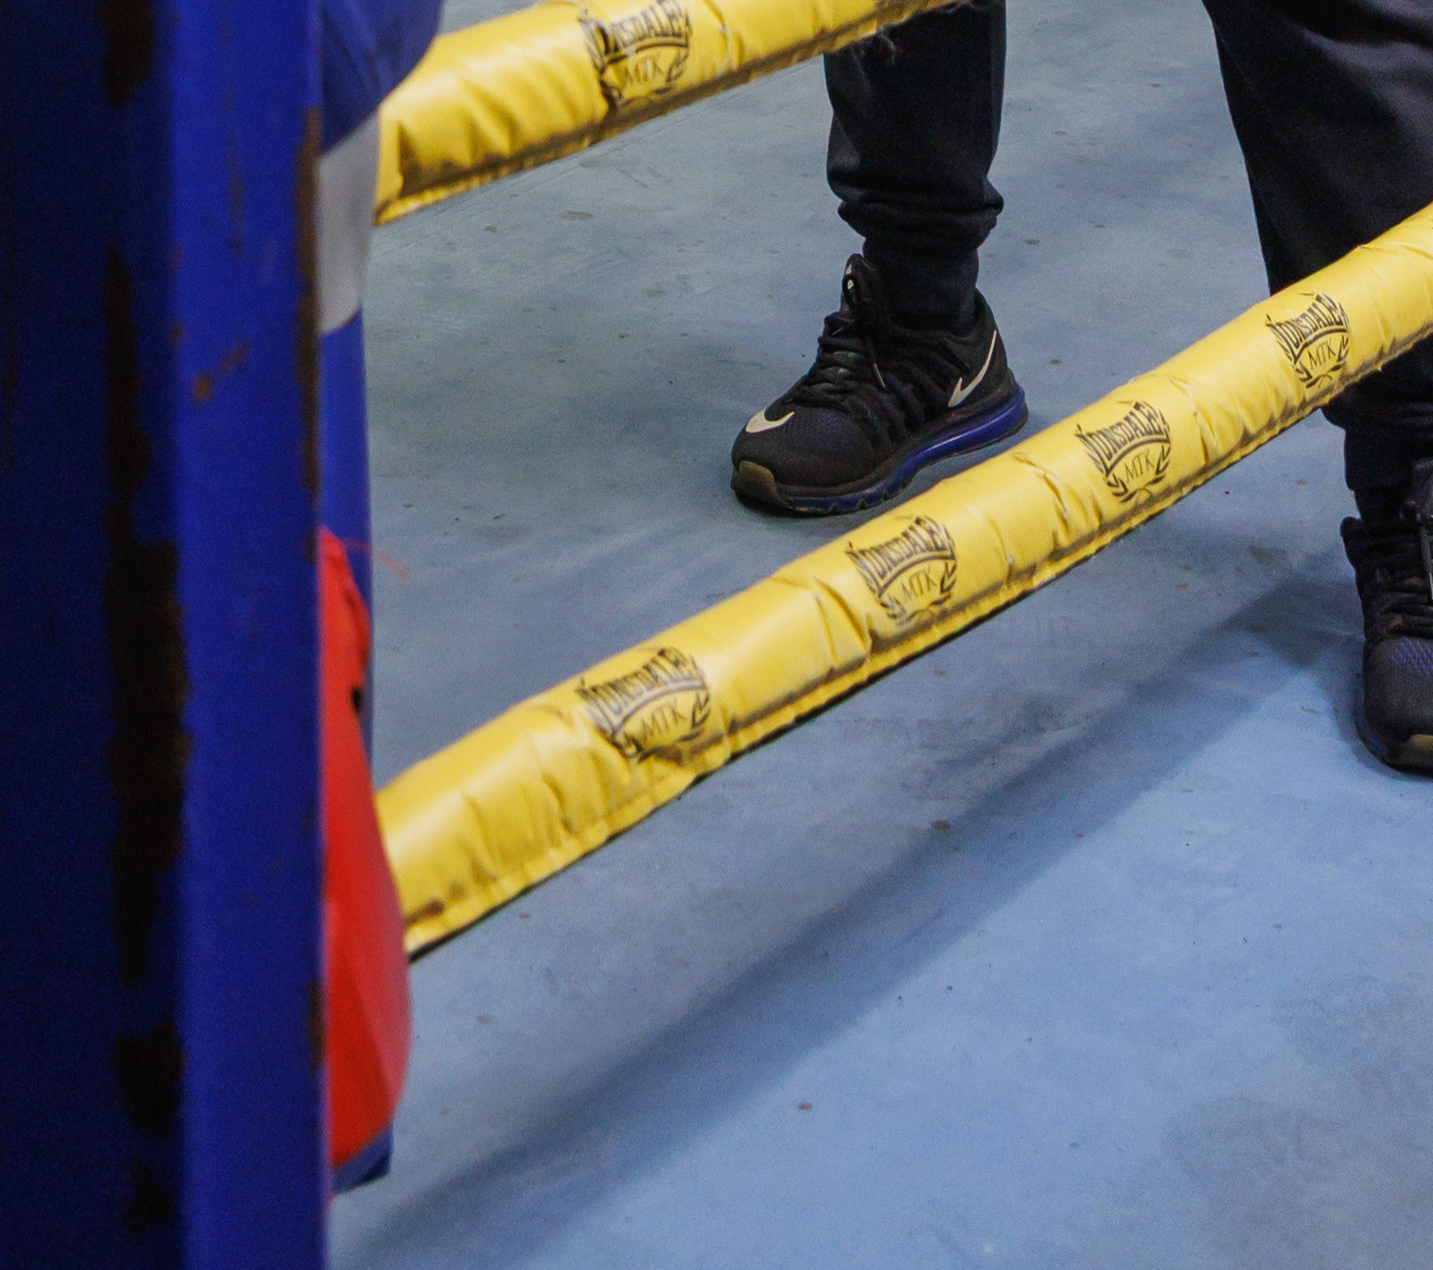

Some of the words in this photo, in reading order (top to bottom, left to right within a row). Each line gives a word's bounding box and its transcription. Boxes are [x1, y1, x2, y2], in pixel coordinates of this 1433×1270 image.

[1267, 293, 1348, 366] LONSDALE
[1308, 337, 1338, 371] MTK
[1077, 402, 1170, 475] LONSDALE
[1122, 450, 1157, 484] MTK
[847, 518, 955, 596] LONSDALE
[901, 569, 937, 603] MTK
[579, 650, 704, 739] LONSDALE
[640, 702, 685, 740] MTK
